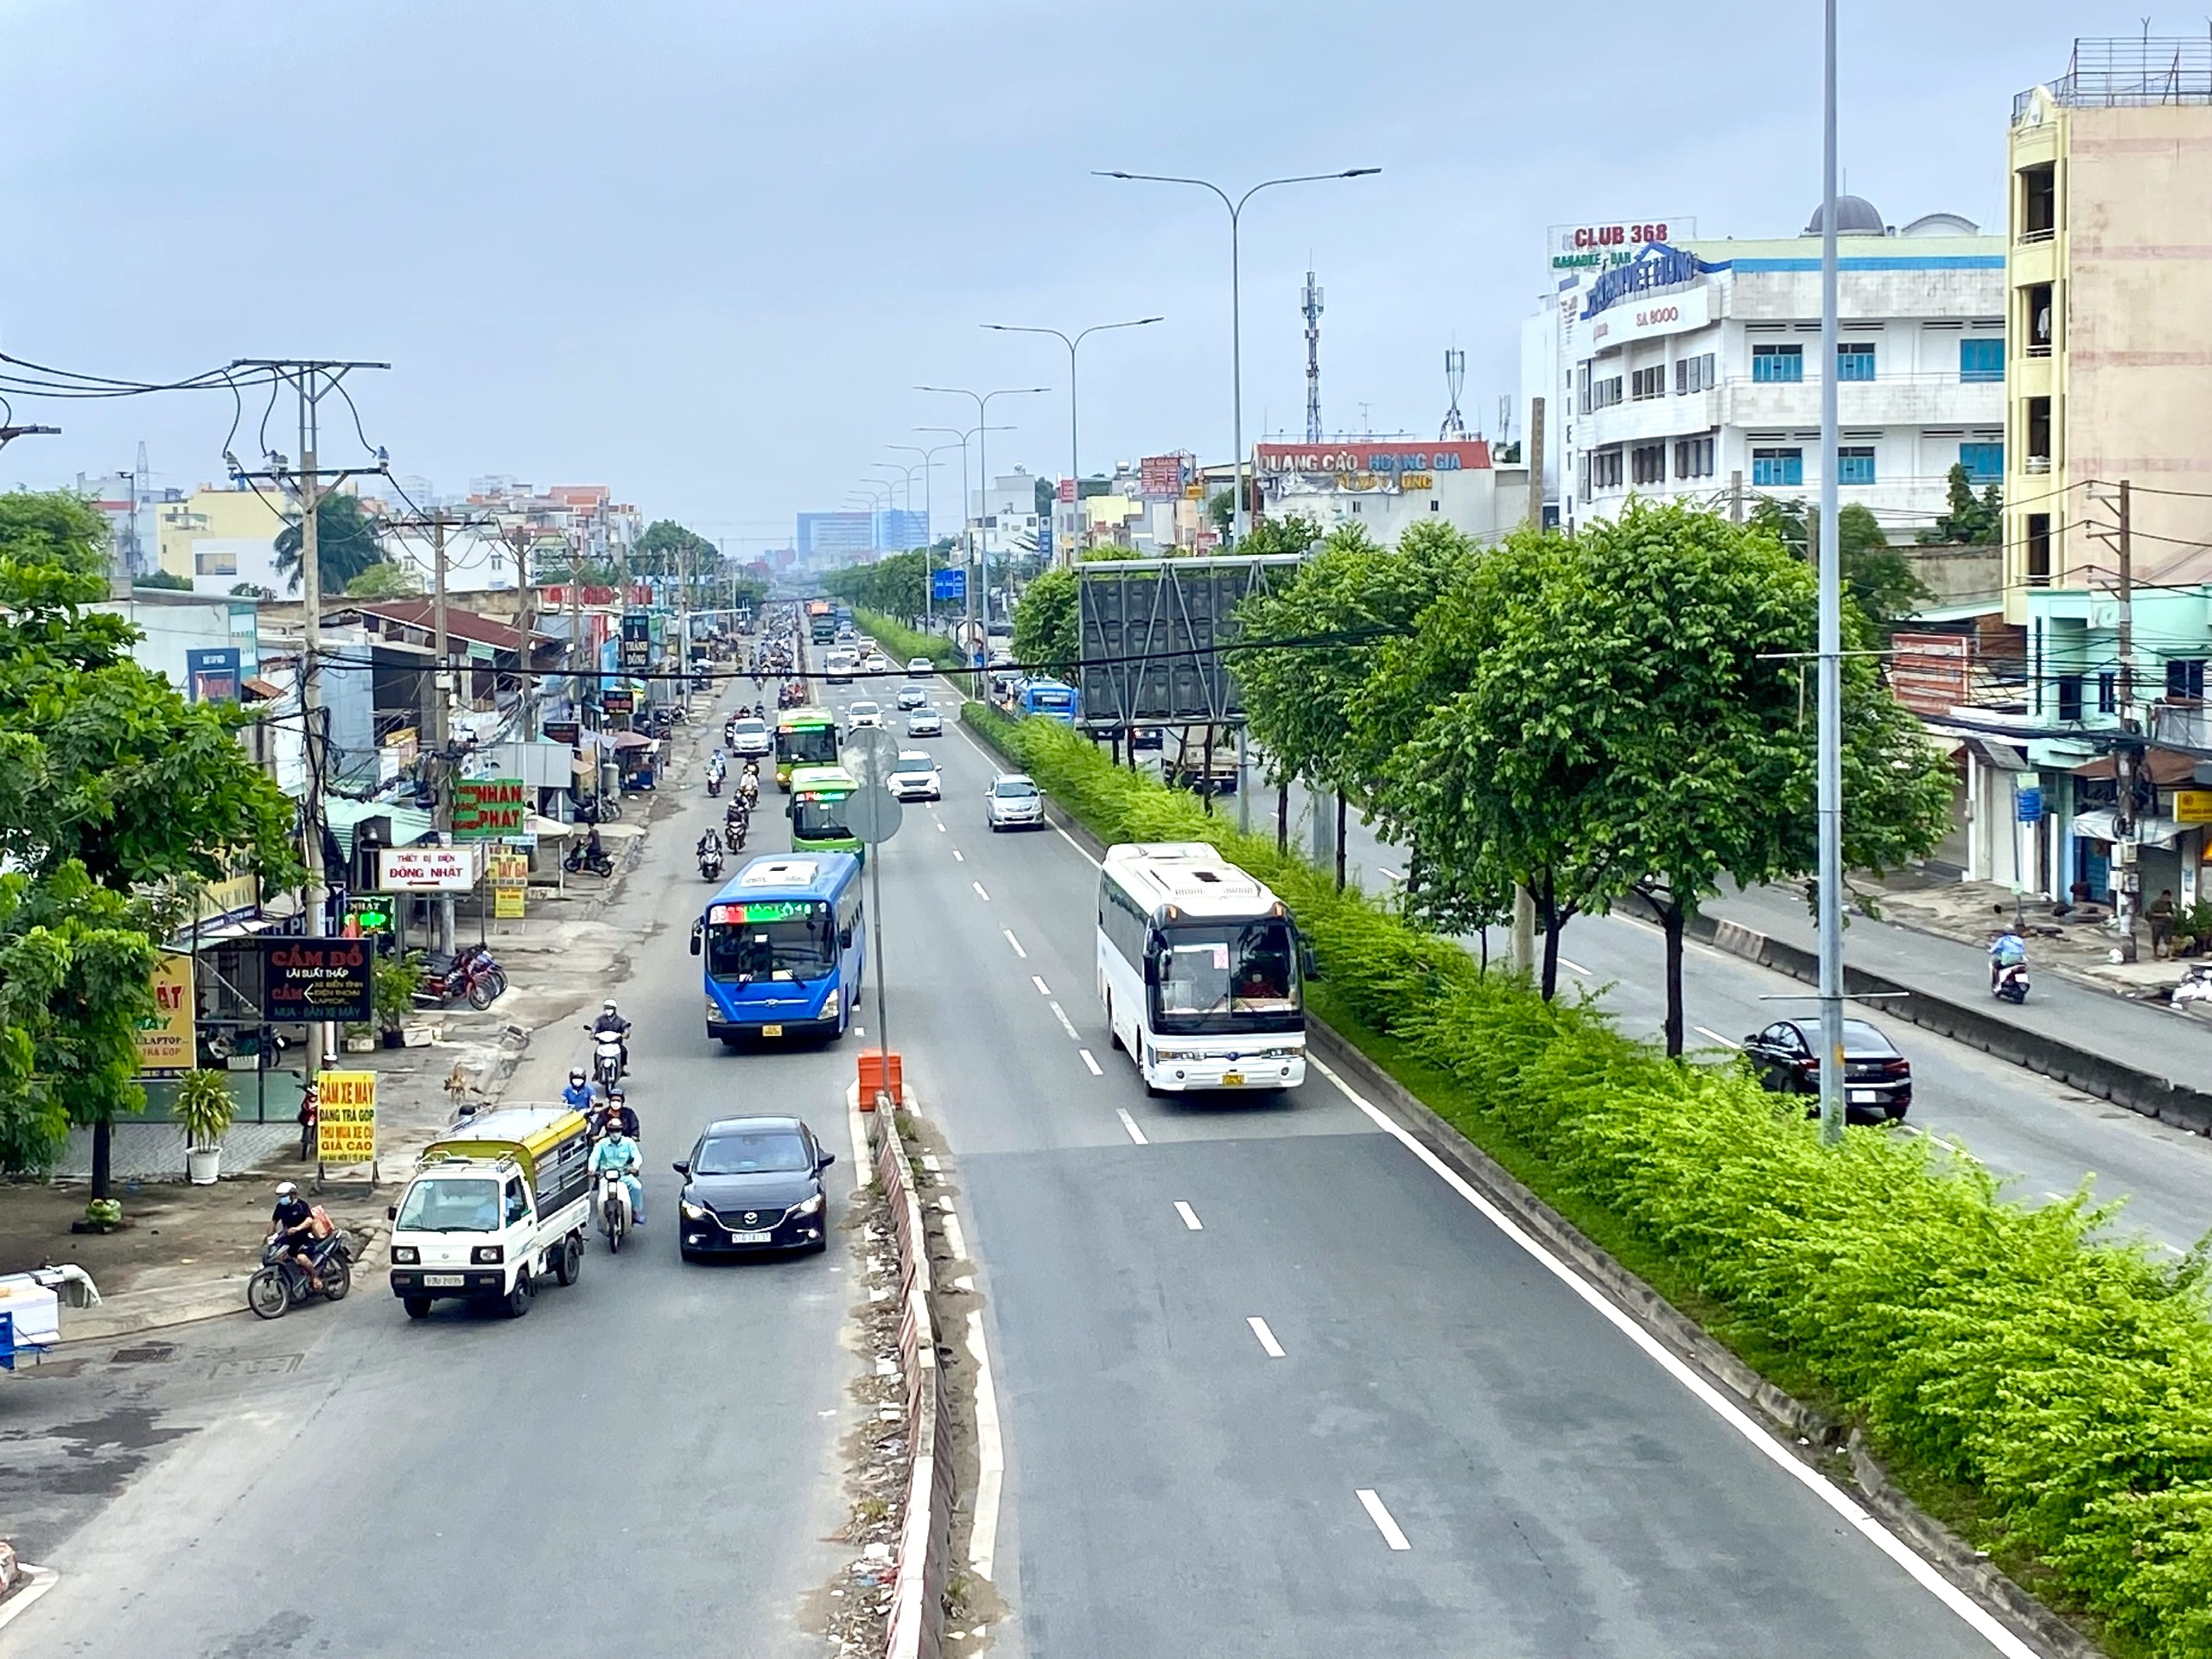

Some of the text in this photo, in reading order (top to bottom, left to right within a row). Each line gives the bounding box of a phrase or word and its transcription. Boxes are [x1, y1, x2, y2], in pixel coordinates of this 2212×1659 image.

[1574, 223, 1669, 247] CLUB 368
[1433, 453, 1462, 470] GIA
[390, 865, 463, 879] ĐÔNG NHẬT
[341, 1082, 353, 1104] XE
[346, 1141, 372, 1151] CAO
